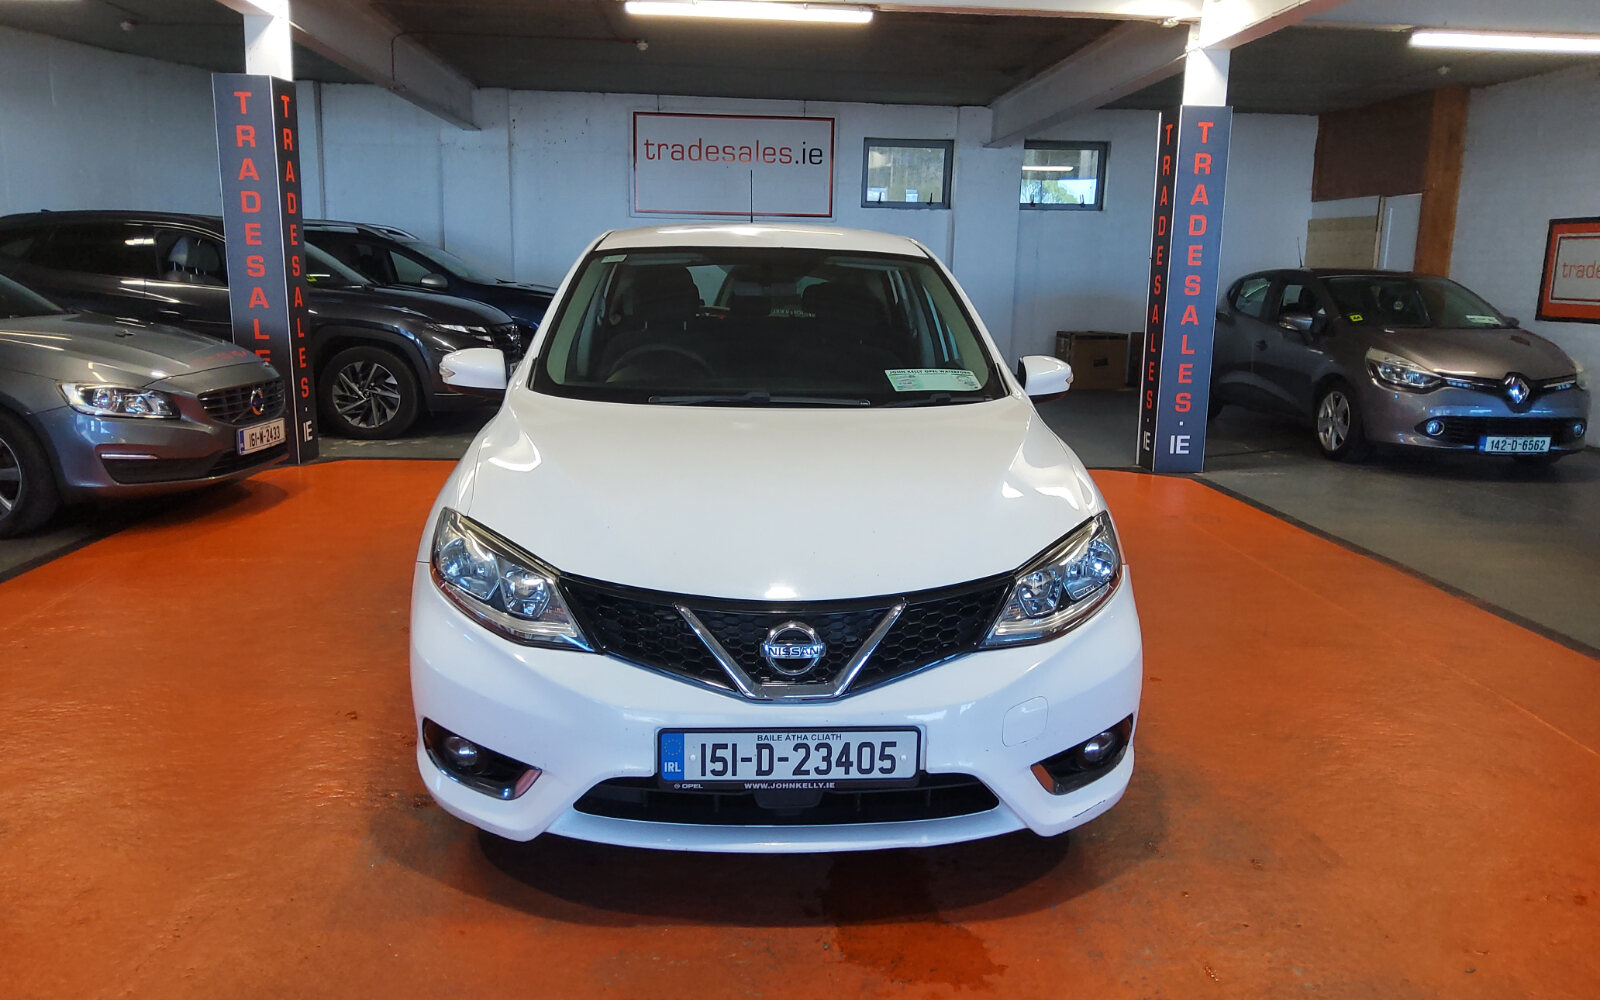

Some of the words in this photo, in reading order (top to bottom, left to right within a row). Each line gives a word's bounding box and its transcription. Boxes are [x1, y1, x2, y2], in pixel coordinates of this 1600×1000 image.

[644, 138, 823, 165] tradesales.ie
[249, 426, 280, 447] 161-W-2433
[1491, 439, 1546, 451] 142-D-6562
[769, 647, 819, 656] NISSAN
[757, 734, 782, 742] BAILE
[811, 733, 842, 741] CLIATH
[700, 742, 898, 777] 151-D-23405
[664, 761, 682, 773] IRL
